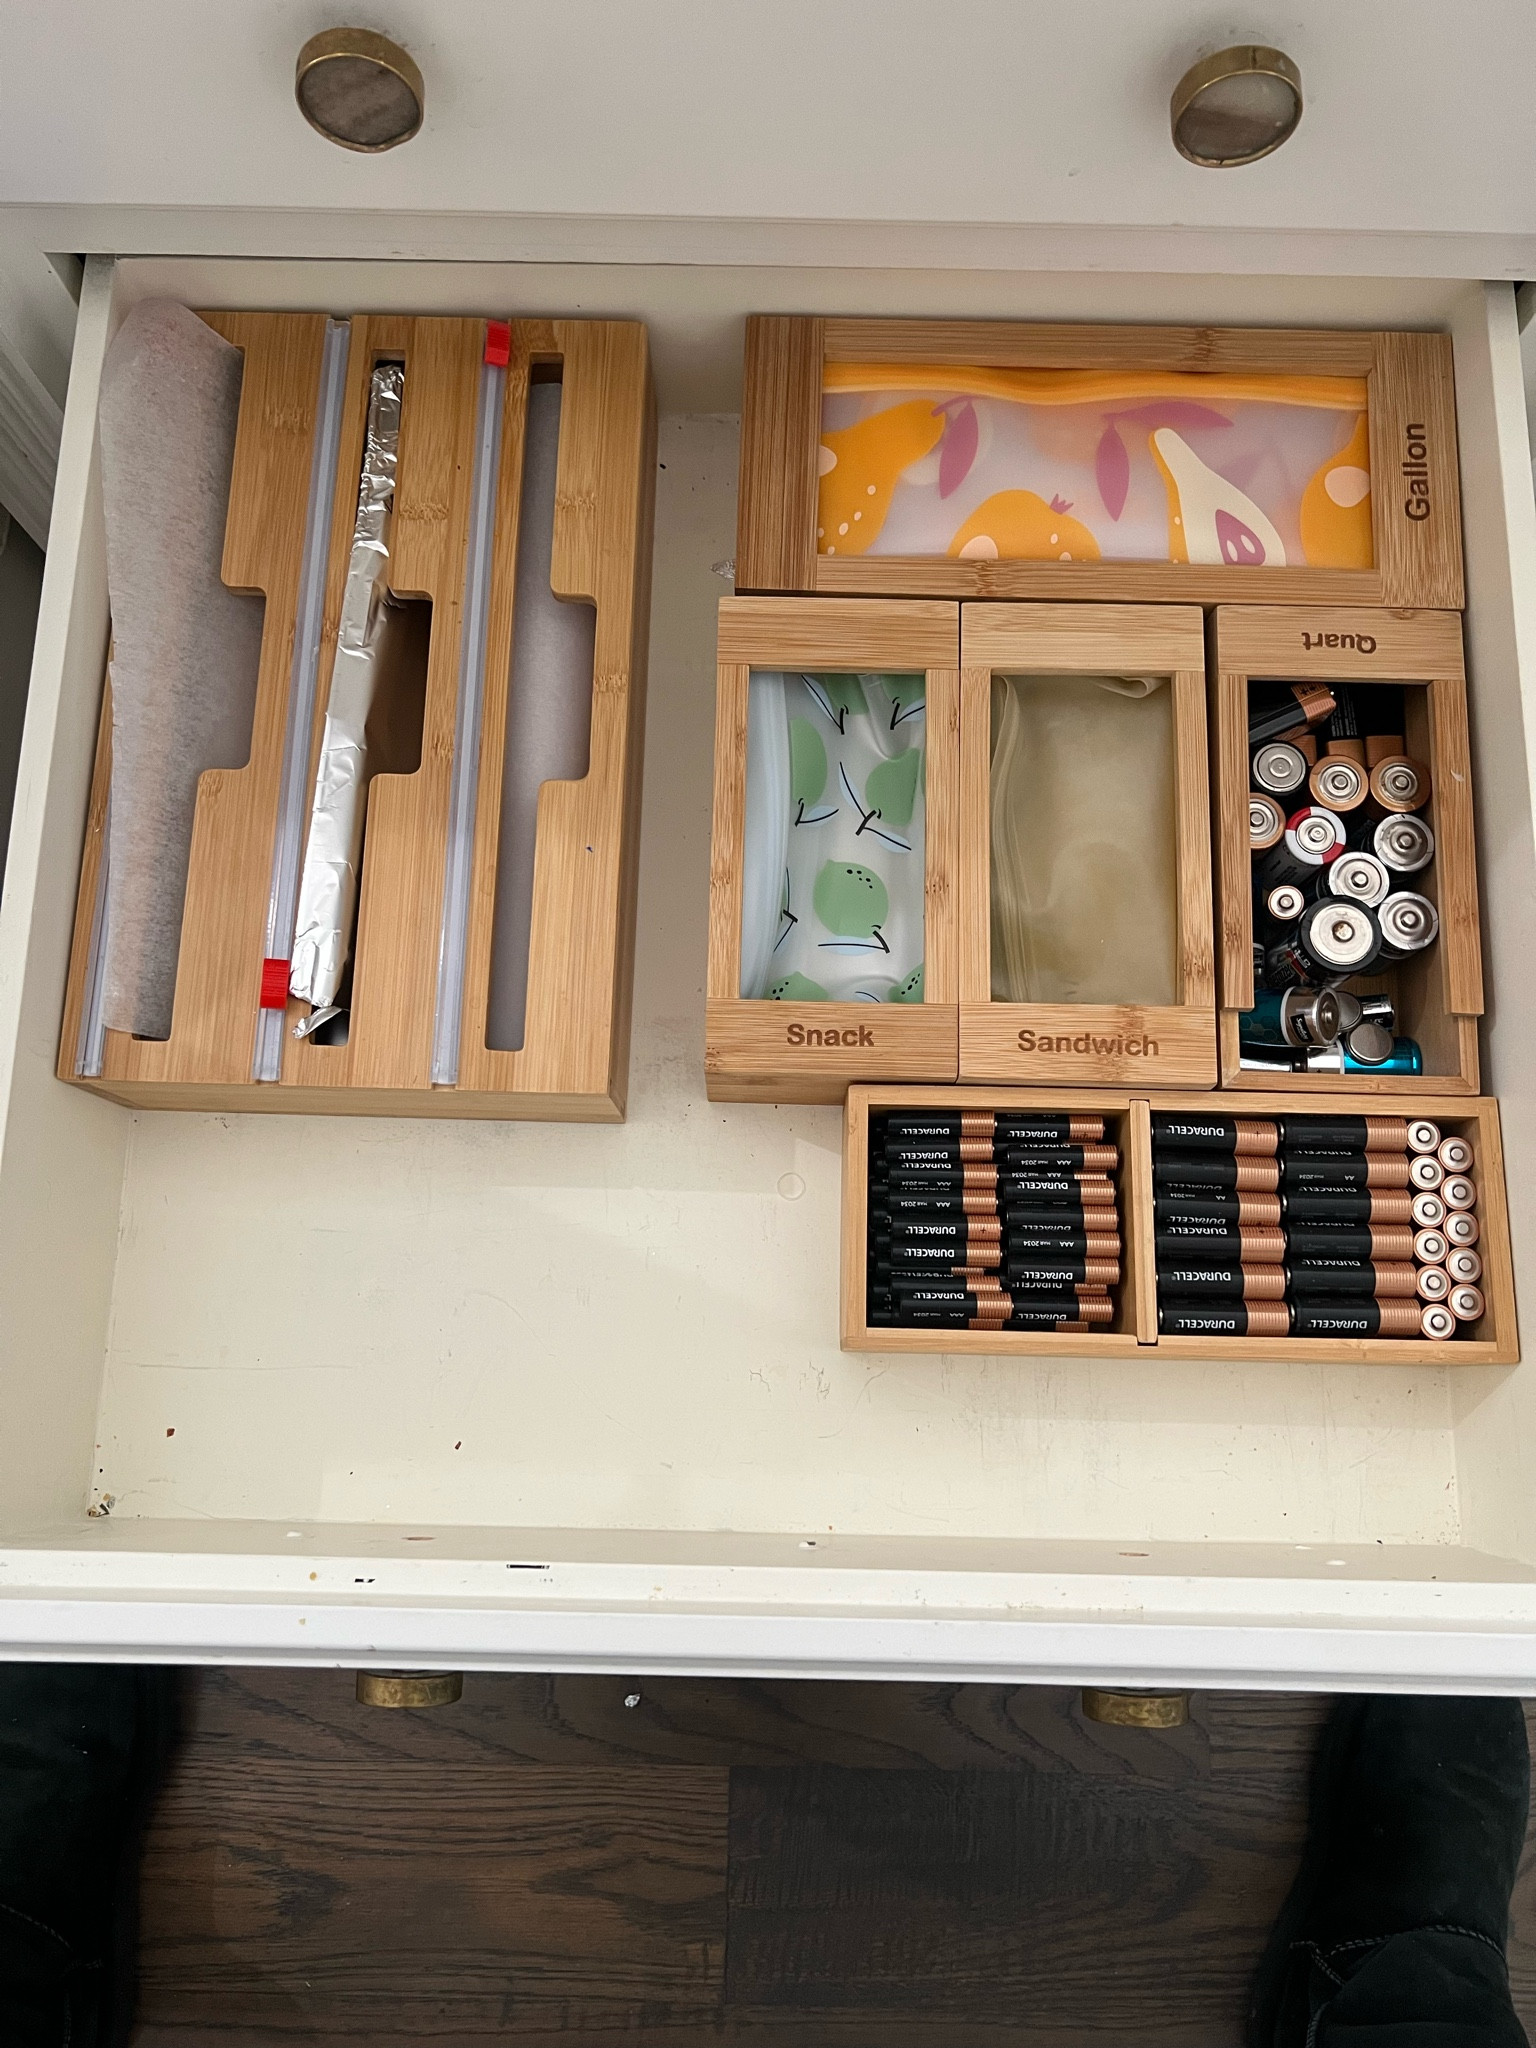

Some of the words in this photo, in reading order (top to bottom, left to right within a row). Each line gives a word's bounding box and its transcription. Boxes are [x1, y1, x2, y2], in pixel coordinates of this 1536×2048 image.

[1403, 423, 1430, 521] Gallon
[1302, 632, 1376, 654] Quart
[786, 1023, 874, 1046] Snack
[1017, 1029, 1159, 1056] Sandwich
[1009, 1130, 1058, 1138] DURACELL
[1168, 1125, 1224, 1136] DURACELL
[900, 1152, 948, 1160] DURACELL
[907, 1226, 956, 1234] DURACELL
[906, 1248, 955, 1258] DURACELL
[1023, 1272, 1073, 1280] DURACELL
[1173, 1271, 1231, 1281] DURACELL
[1178, 1319, 1235, 1329] DURACELL
[1311, 1319, 1367, 1329] DURACELL
